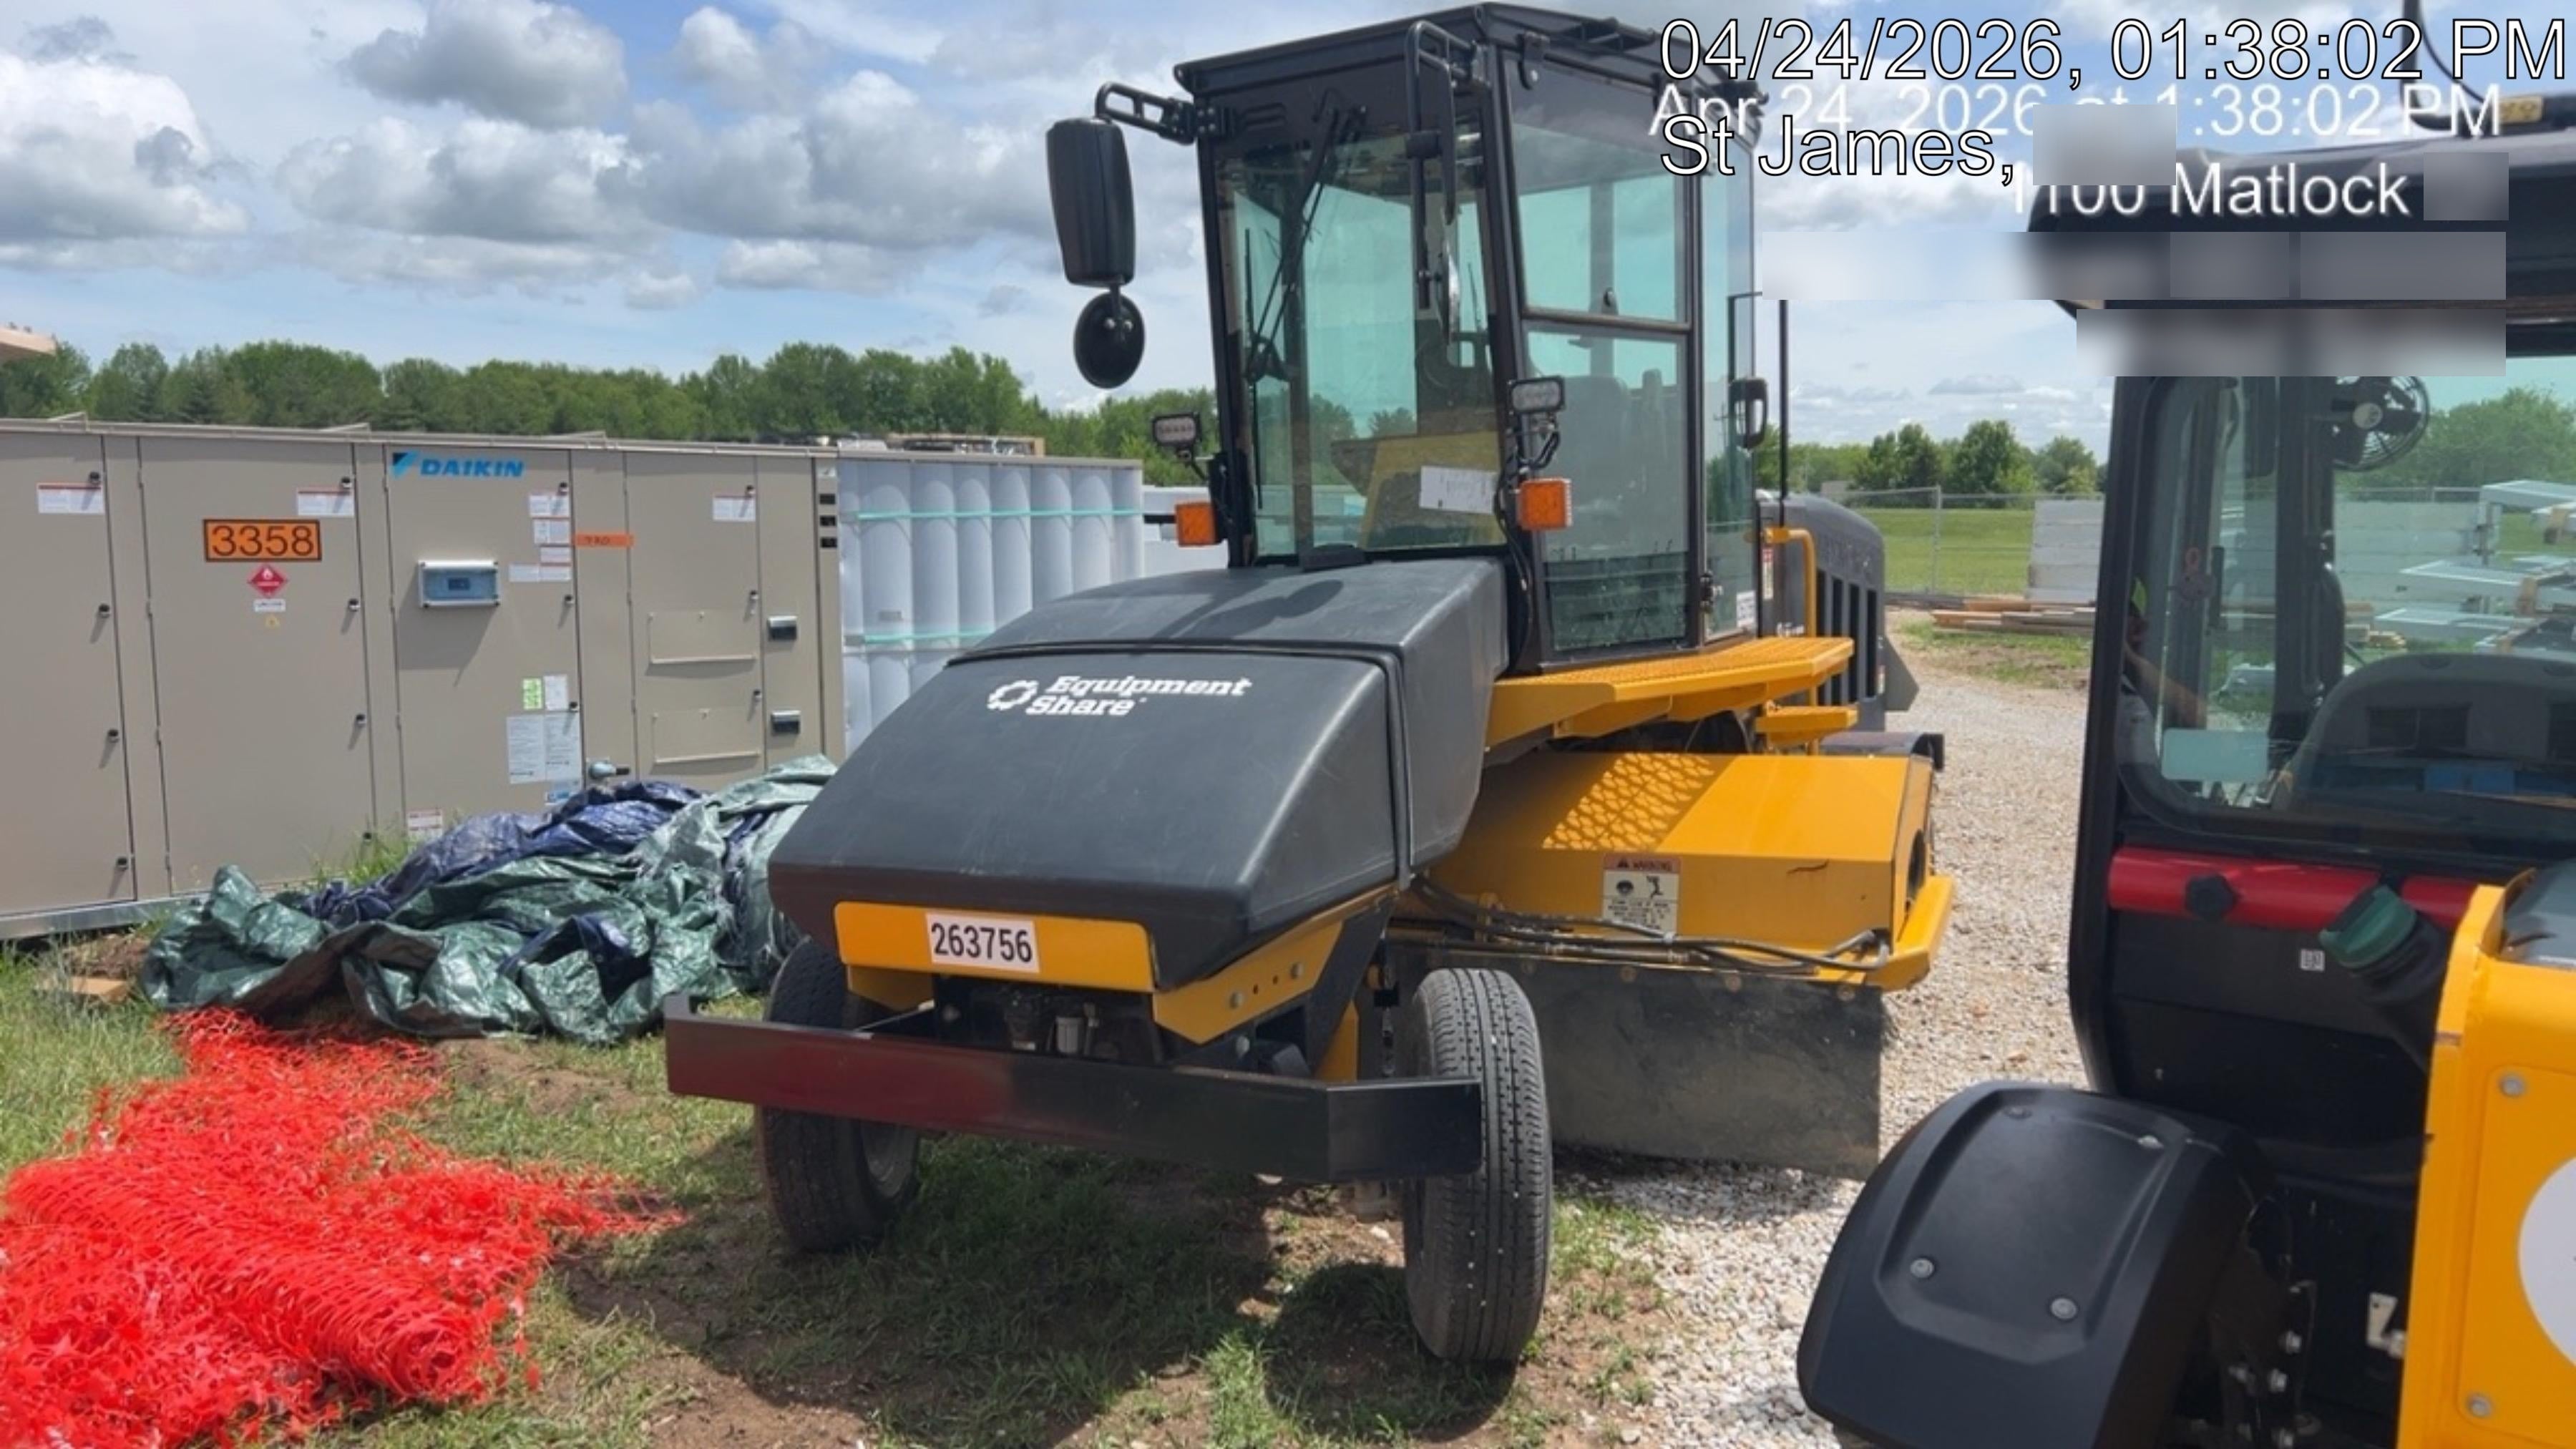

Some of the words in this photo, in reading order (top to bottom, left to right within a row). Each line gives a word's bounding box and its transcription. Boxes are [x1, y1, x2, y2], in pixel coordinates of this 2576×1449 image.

[421, 459, 524, 477] DAIKIN
[213, 525, 313, 556] 3358
[1045, 675, 1252, 697] Equipment
[1025, 695, 1136, 716] Share
[932, 922, 1033, 962] 263756
